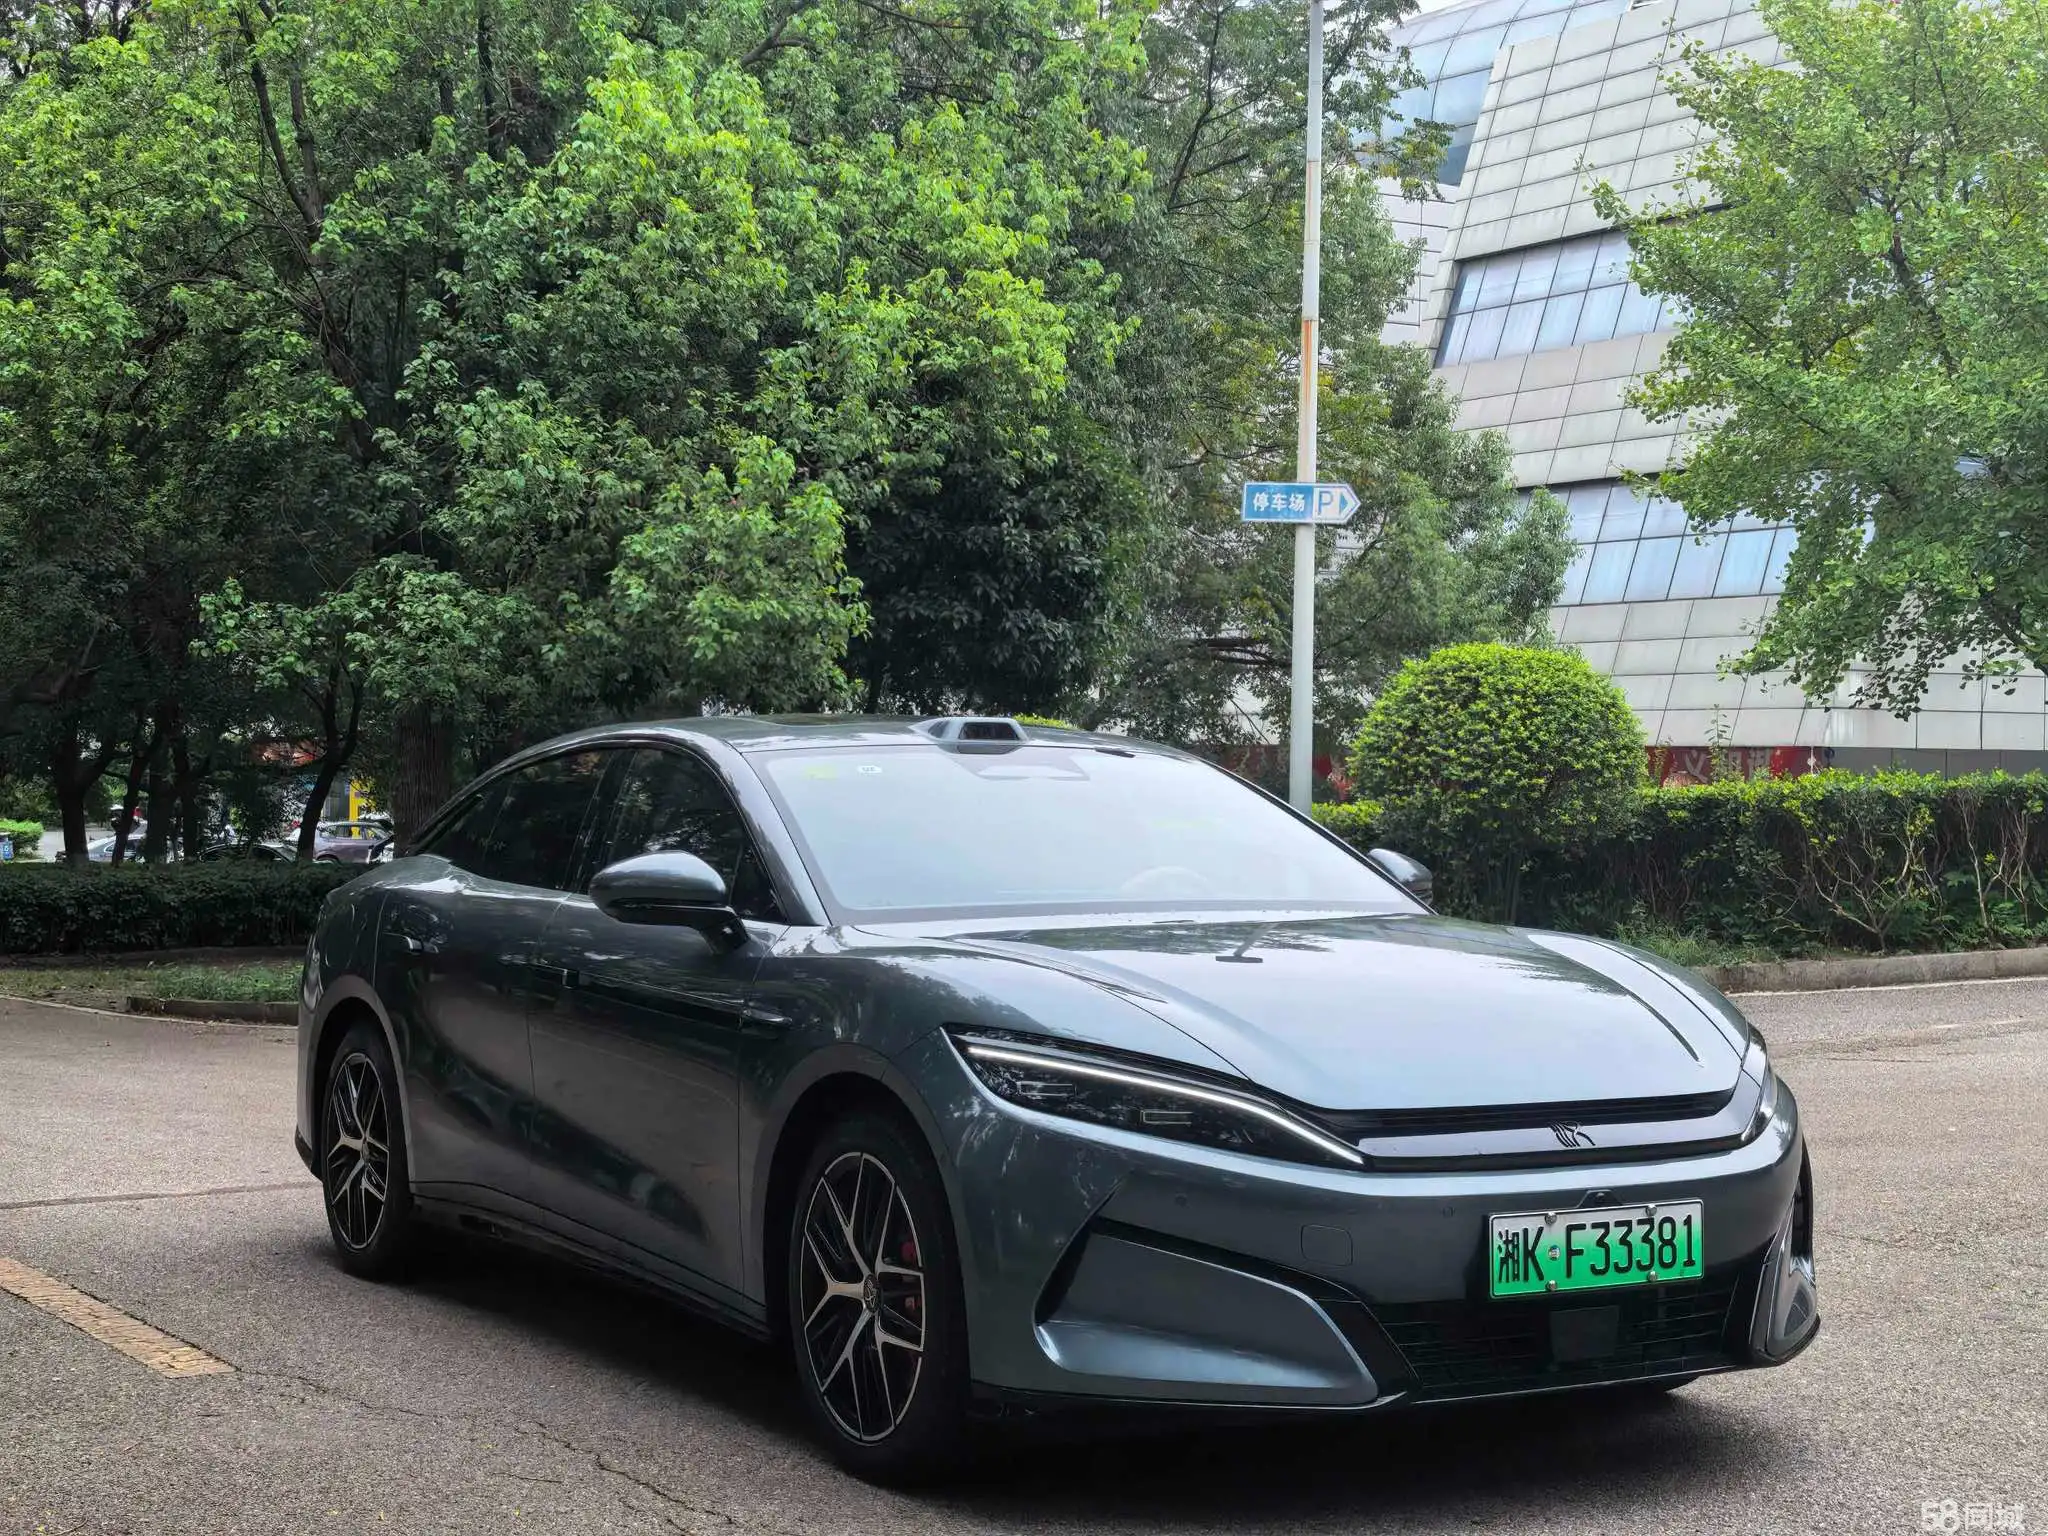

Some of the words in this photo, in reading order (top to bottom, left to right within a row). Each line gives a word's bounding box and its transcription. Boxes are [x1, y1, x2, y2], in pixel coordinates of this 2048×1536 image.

[1253, 491, 1306, 513] 停车场
[1318, 490, 1334, 515] P
